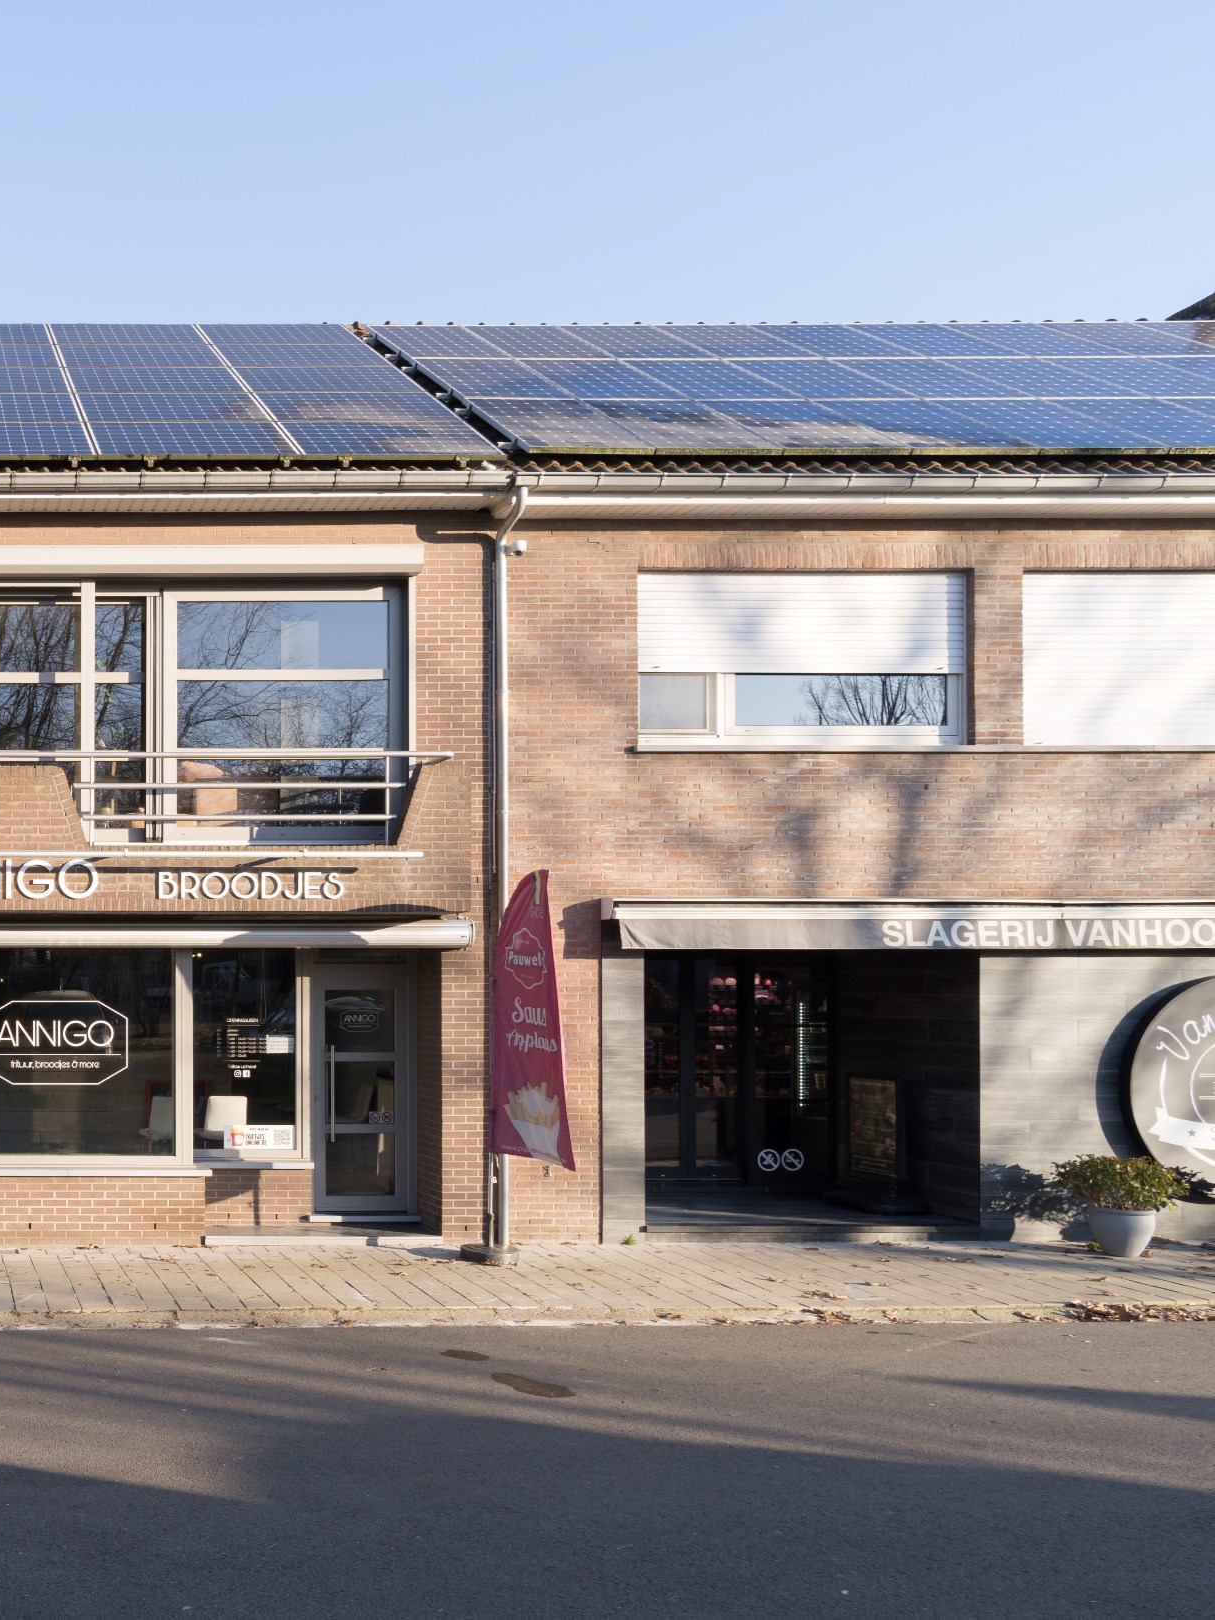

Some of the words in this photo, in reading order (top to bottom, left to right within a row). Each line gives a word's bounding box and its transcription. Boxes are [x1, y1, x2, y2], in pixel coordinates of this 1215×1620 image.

[158, 871, 346, 900] BROODJES
[881, 919, 1055, 948] SLAGERIJ
[344, 1014, 376, 1023] ANNIGO
[512, 997, 547, 1027] Saus
[506, 1028, 558, 1053] Applaus
[35, 1060, 71, 1070] broodjes
[79, 1060, 100, 1069] more
